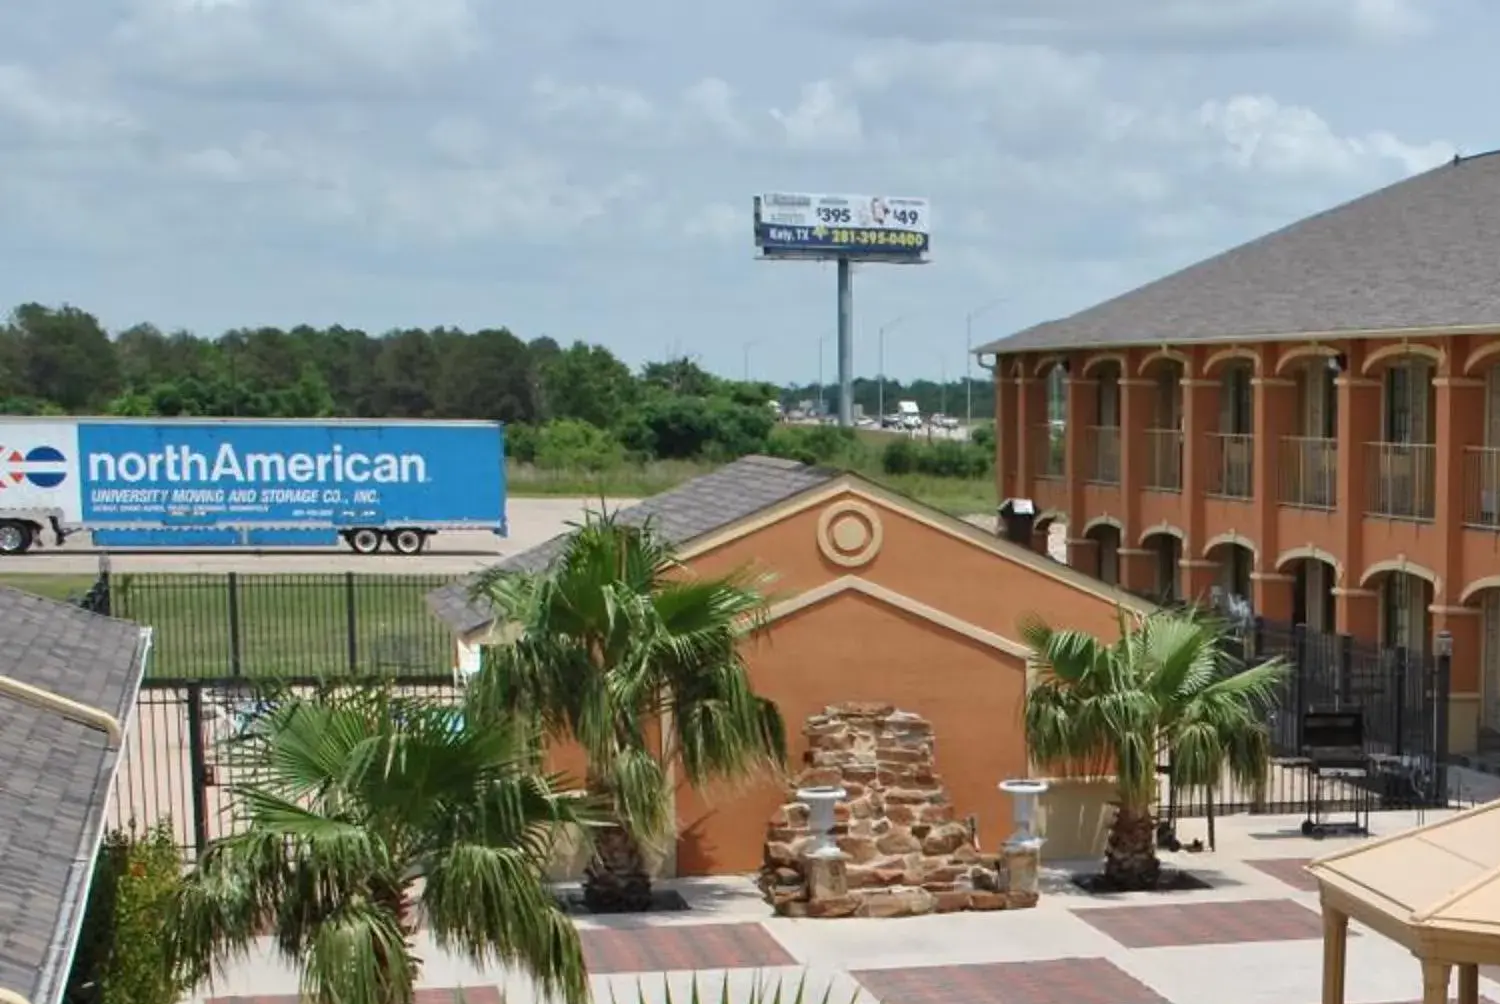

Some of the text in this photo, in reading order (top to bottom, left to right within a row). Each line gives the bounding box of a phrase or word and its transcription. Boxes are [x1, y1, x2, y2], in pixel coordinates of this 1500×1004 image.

[817, 207, 851, 222] $395
[88, 443, 426, 484] northAmerican
[91, 489, 168, 503] UNIVERSITY
[171, 489, 224, 503] MOVING
[228, 489, 257, 503] AND
[261, 489, 320, 503] STORAGE
